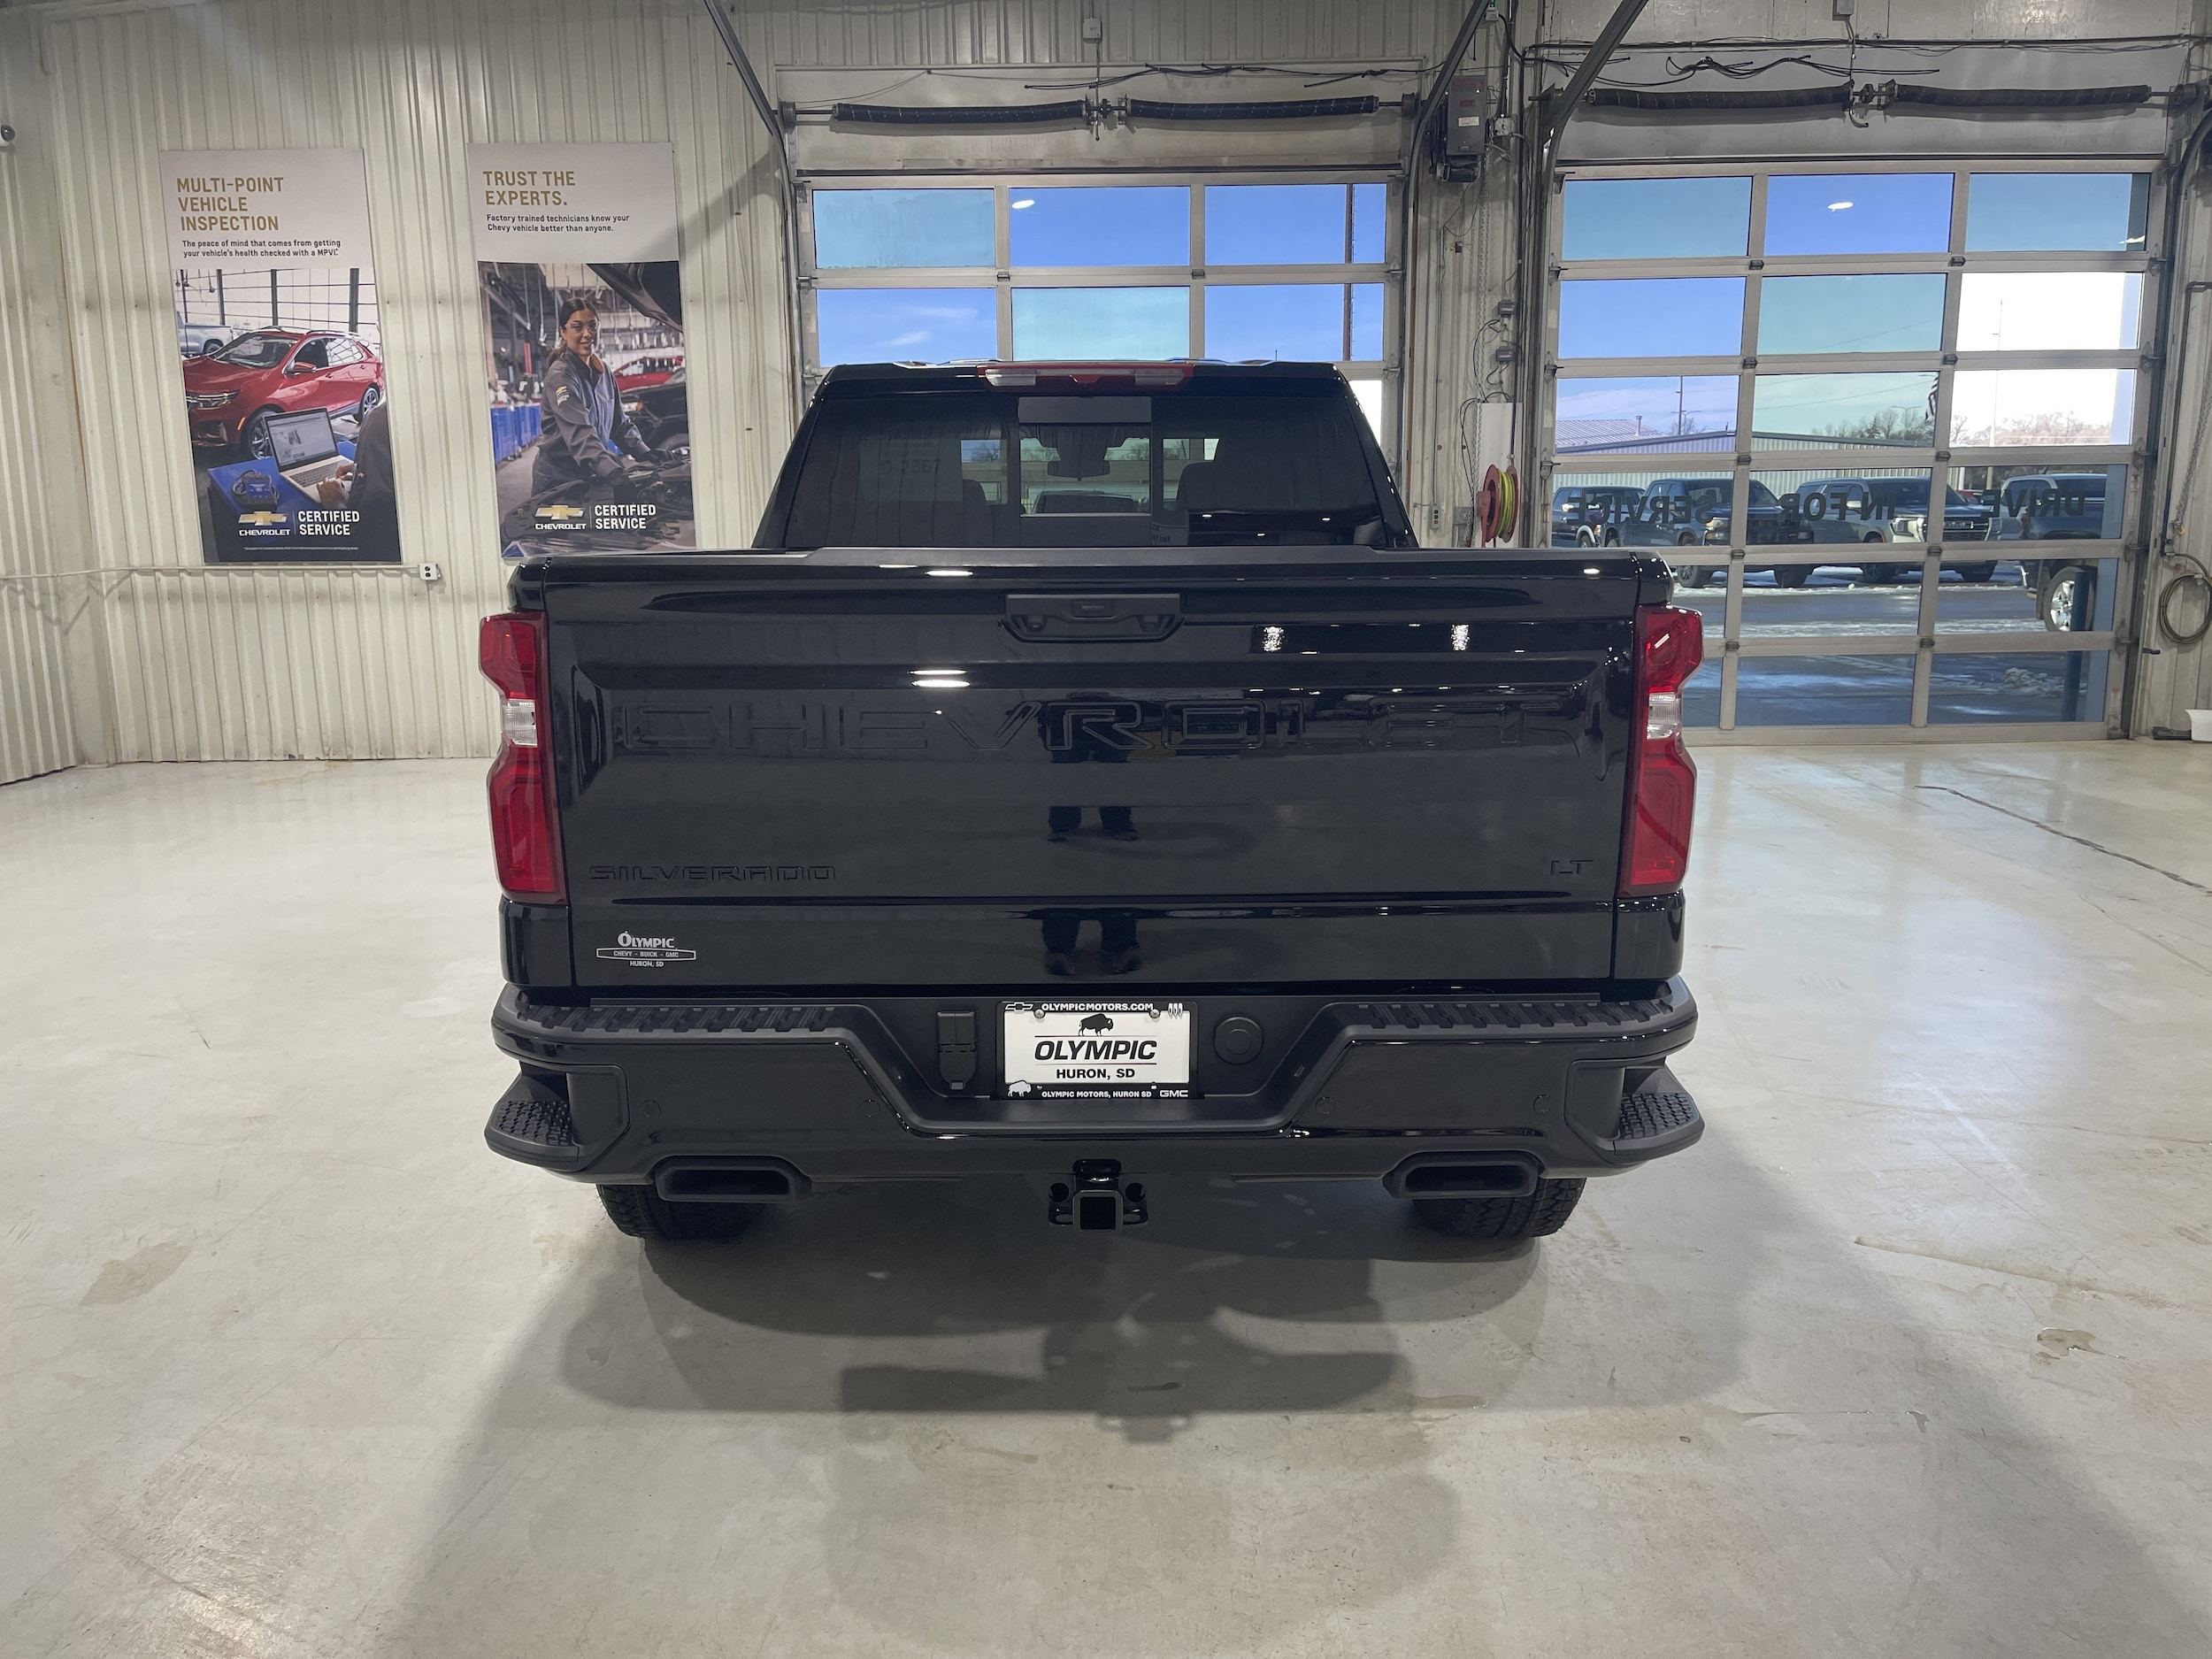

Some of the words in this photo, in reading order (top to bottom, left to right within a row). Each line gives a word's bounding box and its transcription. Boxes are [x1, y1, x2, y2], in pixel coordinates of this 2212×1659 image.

[177, 177, 284, 193] MULTI-POINT
[482, 171, 537, 186] TRUST
[542, 171, 576, 186] THE
[179, 196, 248, 211] VEHICLE
[486, 190, 567, 206] EXPERTS.
[181, 216, 280, 231] INSPECTION
[487, 213, 516, 223] Factory
[613, 214, 630, 223] your
[488, 223, 511, 233] Chevy
[197, 240, 219, 249] peace
[313, 239, 341, 248] getting
[297, 511, 360, 523] CERTIFIED
[594, 504, 657, 517] CERTIFIED
[299, 524, 351, 535] SERVICE
[595, 518, 647, 529] SERVICE
[619, 697, 1563, 750] CHEVROLET
[588, 865, 836, 881] SILVERADO
[1550, 859, 1594, 875] LT
[617, 932, 675, 949] OLYMPIC
[1041, 1002, 1154, 1011] OLYMPICMOTORS.COM
[1034, 1040, 1157, 1060] OLYMPIC
[1056, 1068, 1110, 1080] HURON,
[1116, 1068, 1135, 1079] SD
